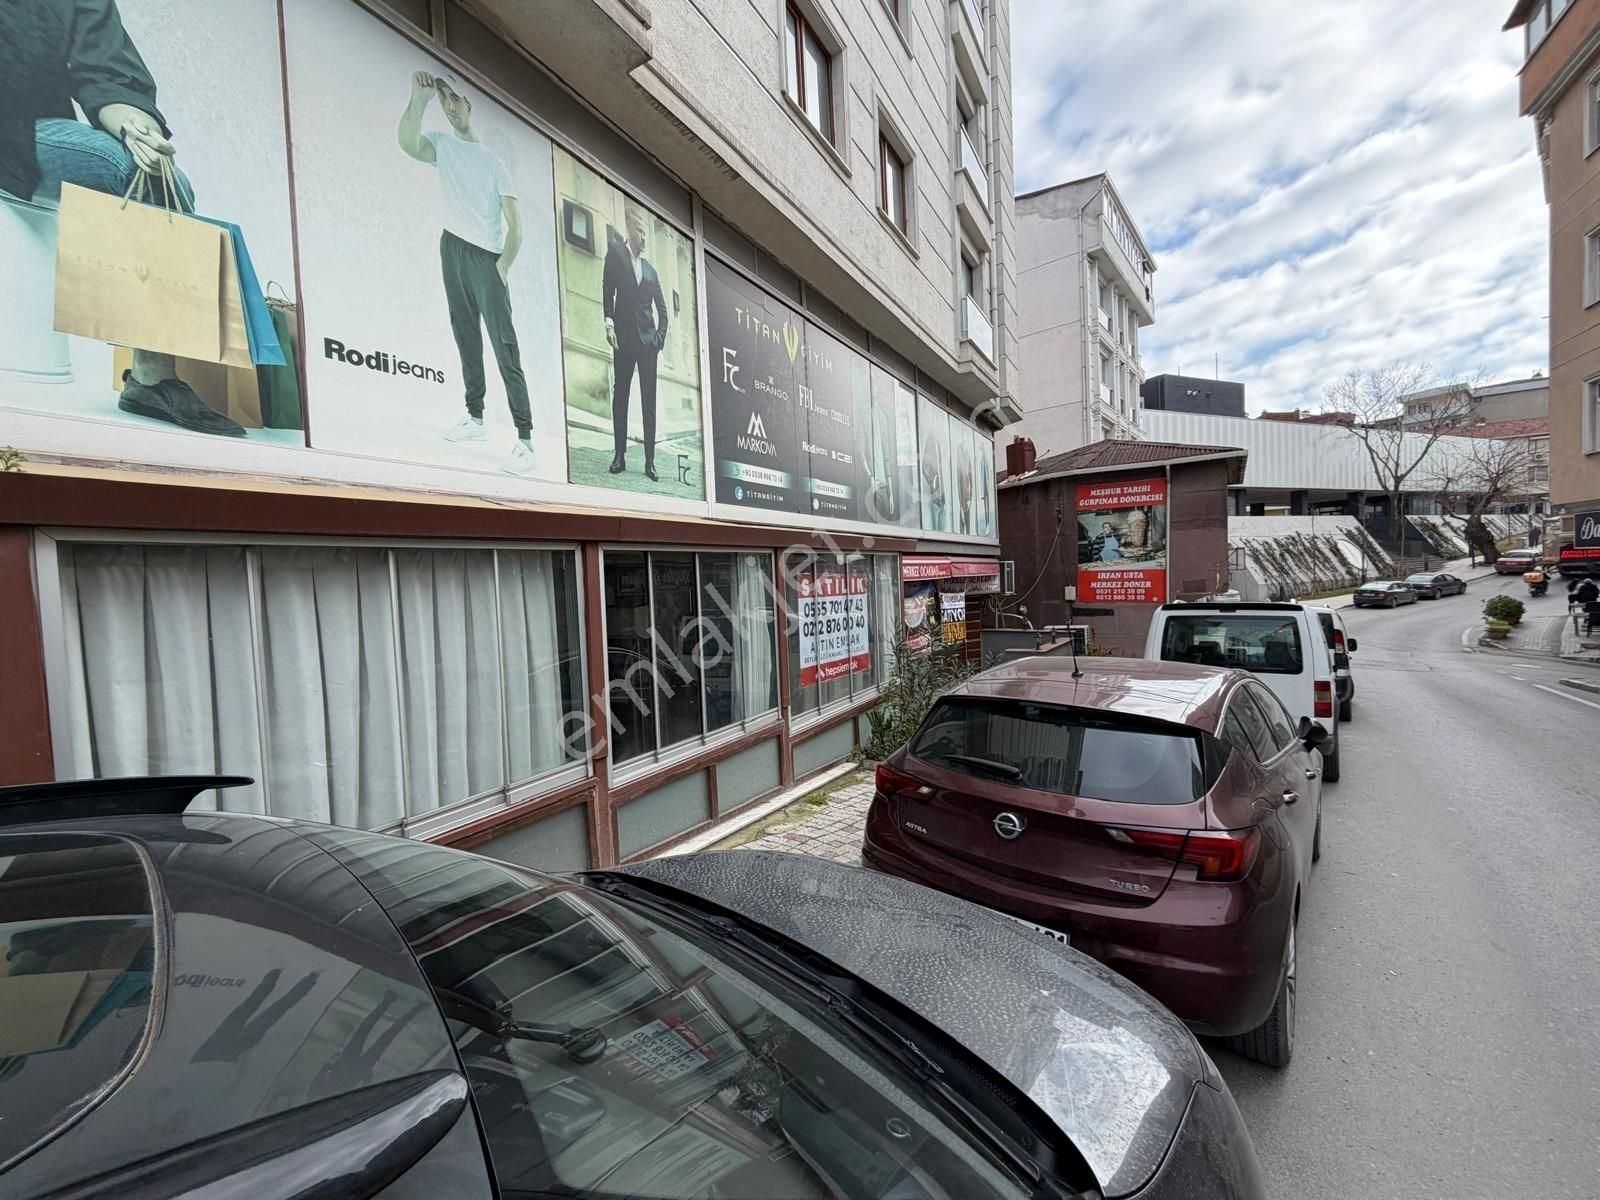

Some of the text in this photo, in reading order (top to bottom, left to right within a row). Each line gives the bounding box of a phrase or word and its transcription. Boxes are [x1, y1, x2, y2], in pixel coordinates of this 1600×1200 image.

[754, 379, 789, 401] BRANGO
[736, 433, 778, 458] MARKOVA
[1123, 571, 1144, 579] USTA
[1090, 581, 1122, 589] MERKEZ
[826, 617, 841, 634] 876
[905, 821, 928, 835] ASTRA
[1109, 878, 1151, 894] TURBO
